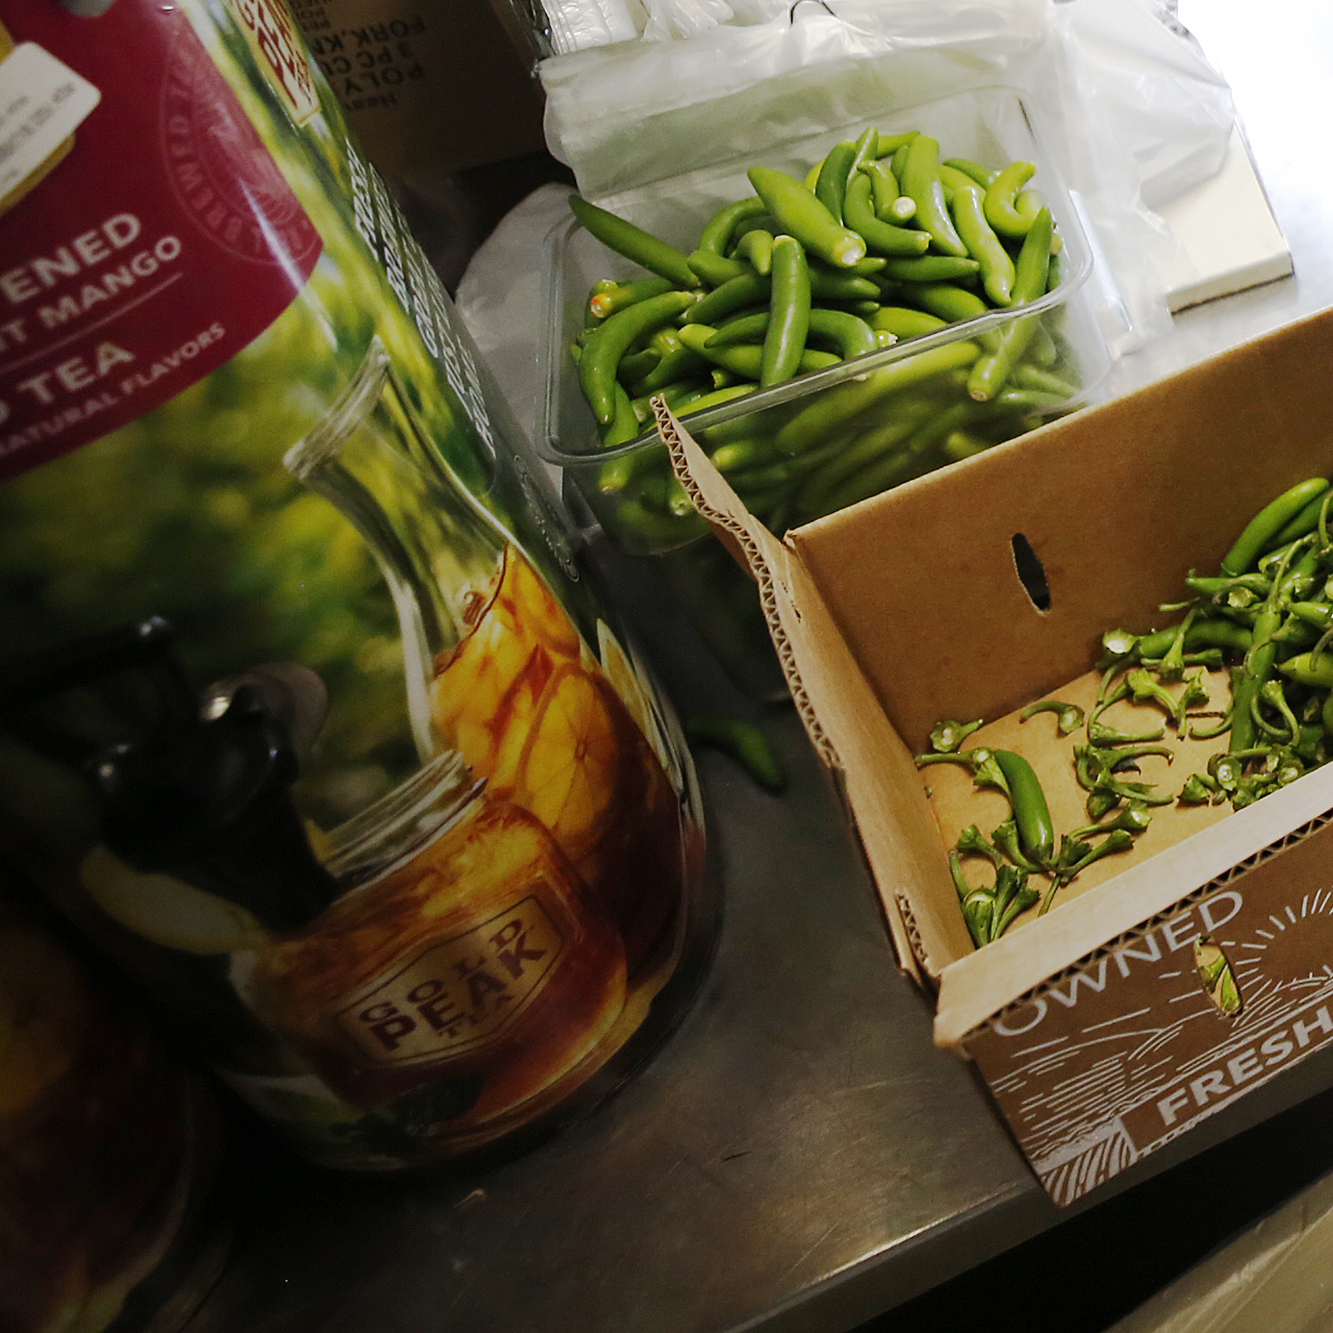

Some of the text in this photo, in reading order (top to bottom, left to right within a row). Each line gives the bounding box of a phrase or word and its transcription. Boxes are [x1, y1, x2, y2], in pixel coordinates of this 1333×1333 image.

[39, 235, 182, 329] MANGO
[17, 342, 136, 405] TEA
[121, 322, 226, 395] FLAVORS
[368, 930, 548, 1053] PEAK
